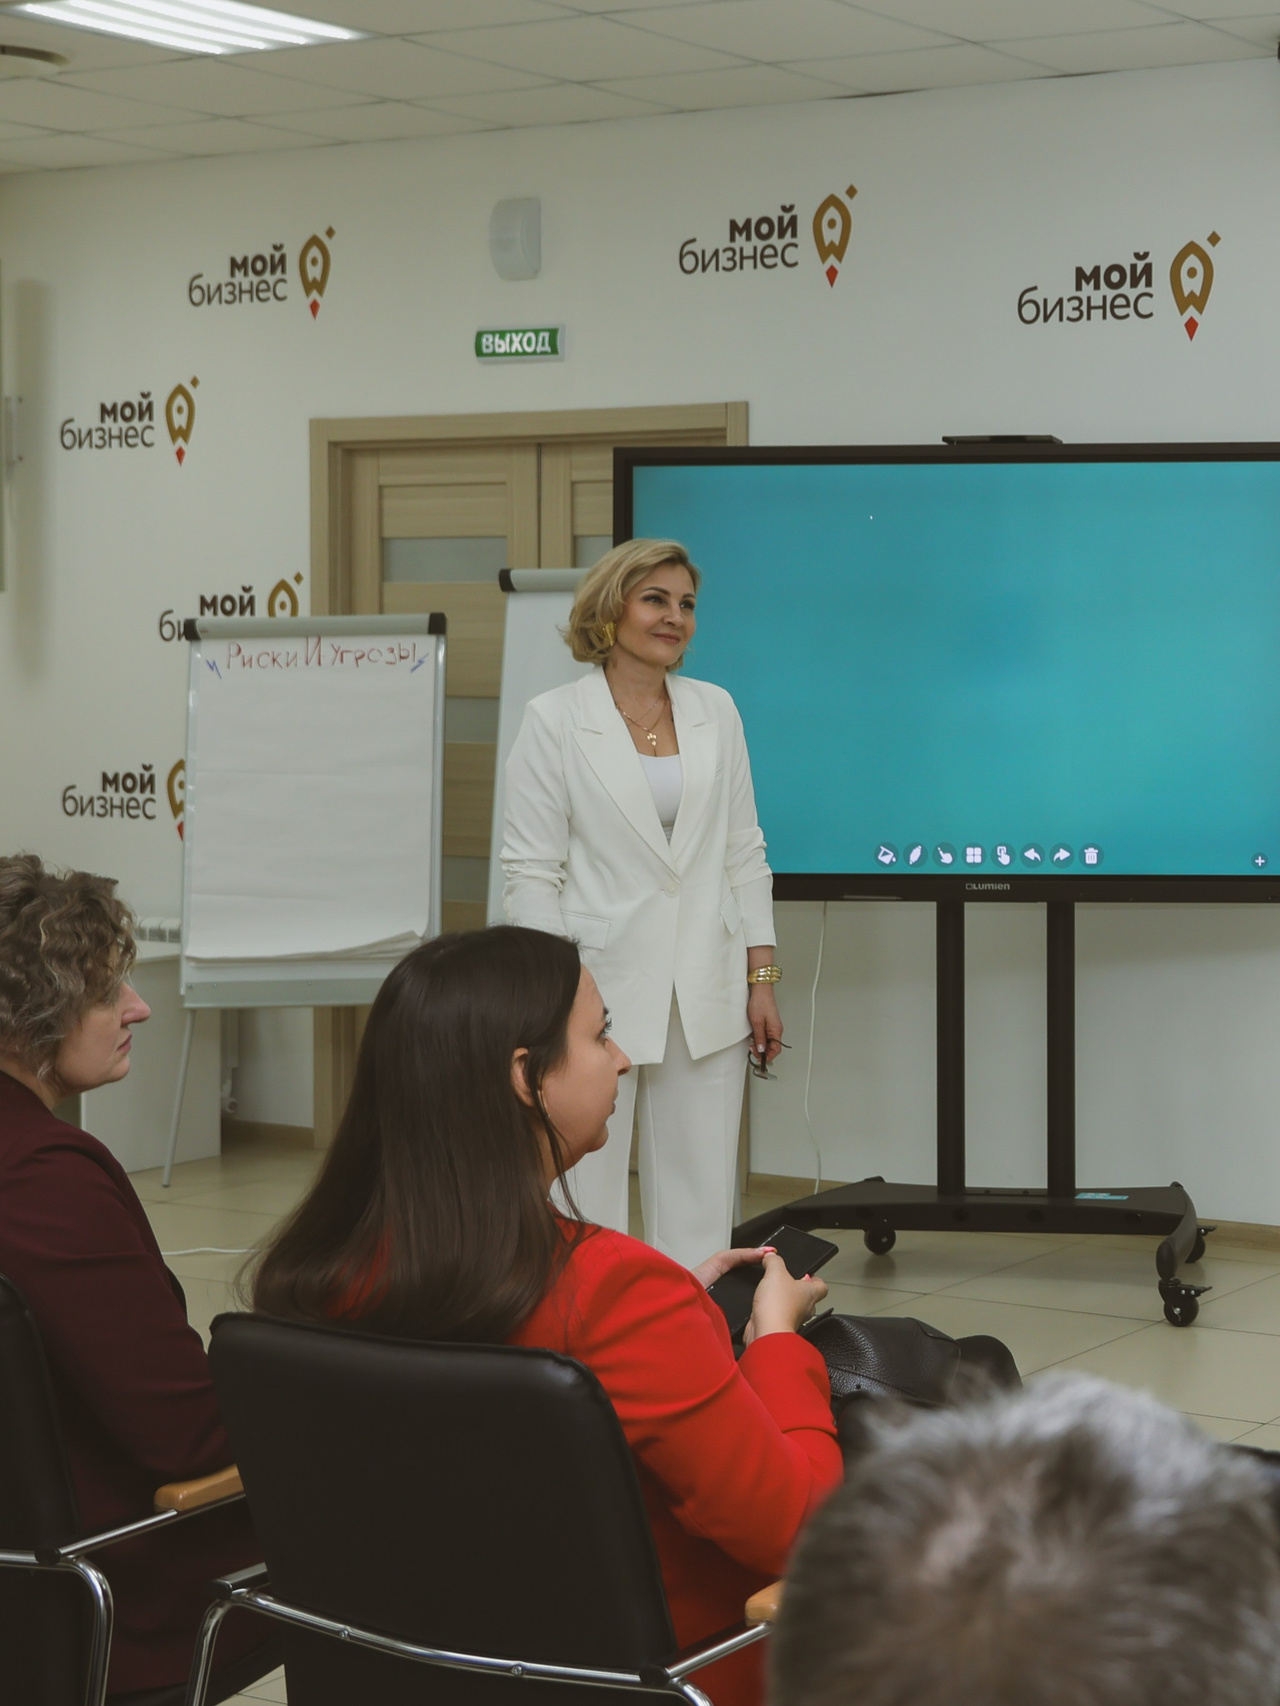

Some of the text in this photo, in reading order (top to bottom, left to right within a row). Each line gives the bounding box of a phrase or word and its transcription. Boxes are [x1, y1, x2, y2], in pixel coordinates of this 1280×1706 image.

[729, 204, 798, 242] мой
[229, 243, 287, 278] мой
[679, 237, 799, 275] бизнес
[1074, 251, 1154, 291] мой
[188, 273, 288, 307] бизнес
[1017, 286, 1154, 325] бизнес
[482, 331, 552, 354] ВЫХОД
[100, 392, 154, 423] мой
[60, 418, 155, 451] бизнес
[200, 585, 256, 617] мой
[227, 642, 298, 669] Риски
[101, 763, 156, 796] мой
[62, 784, 157, 820] бизнес
